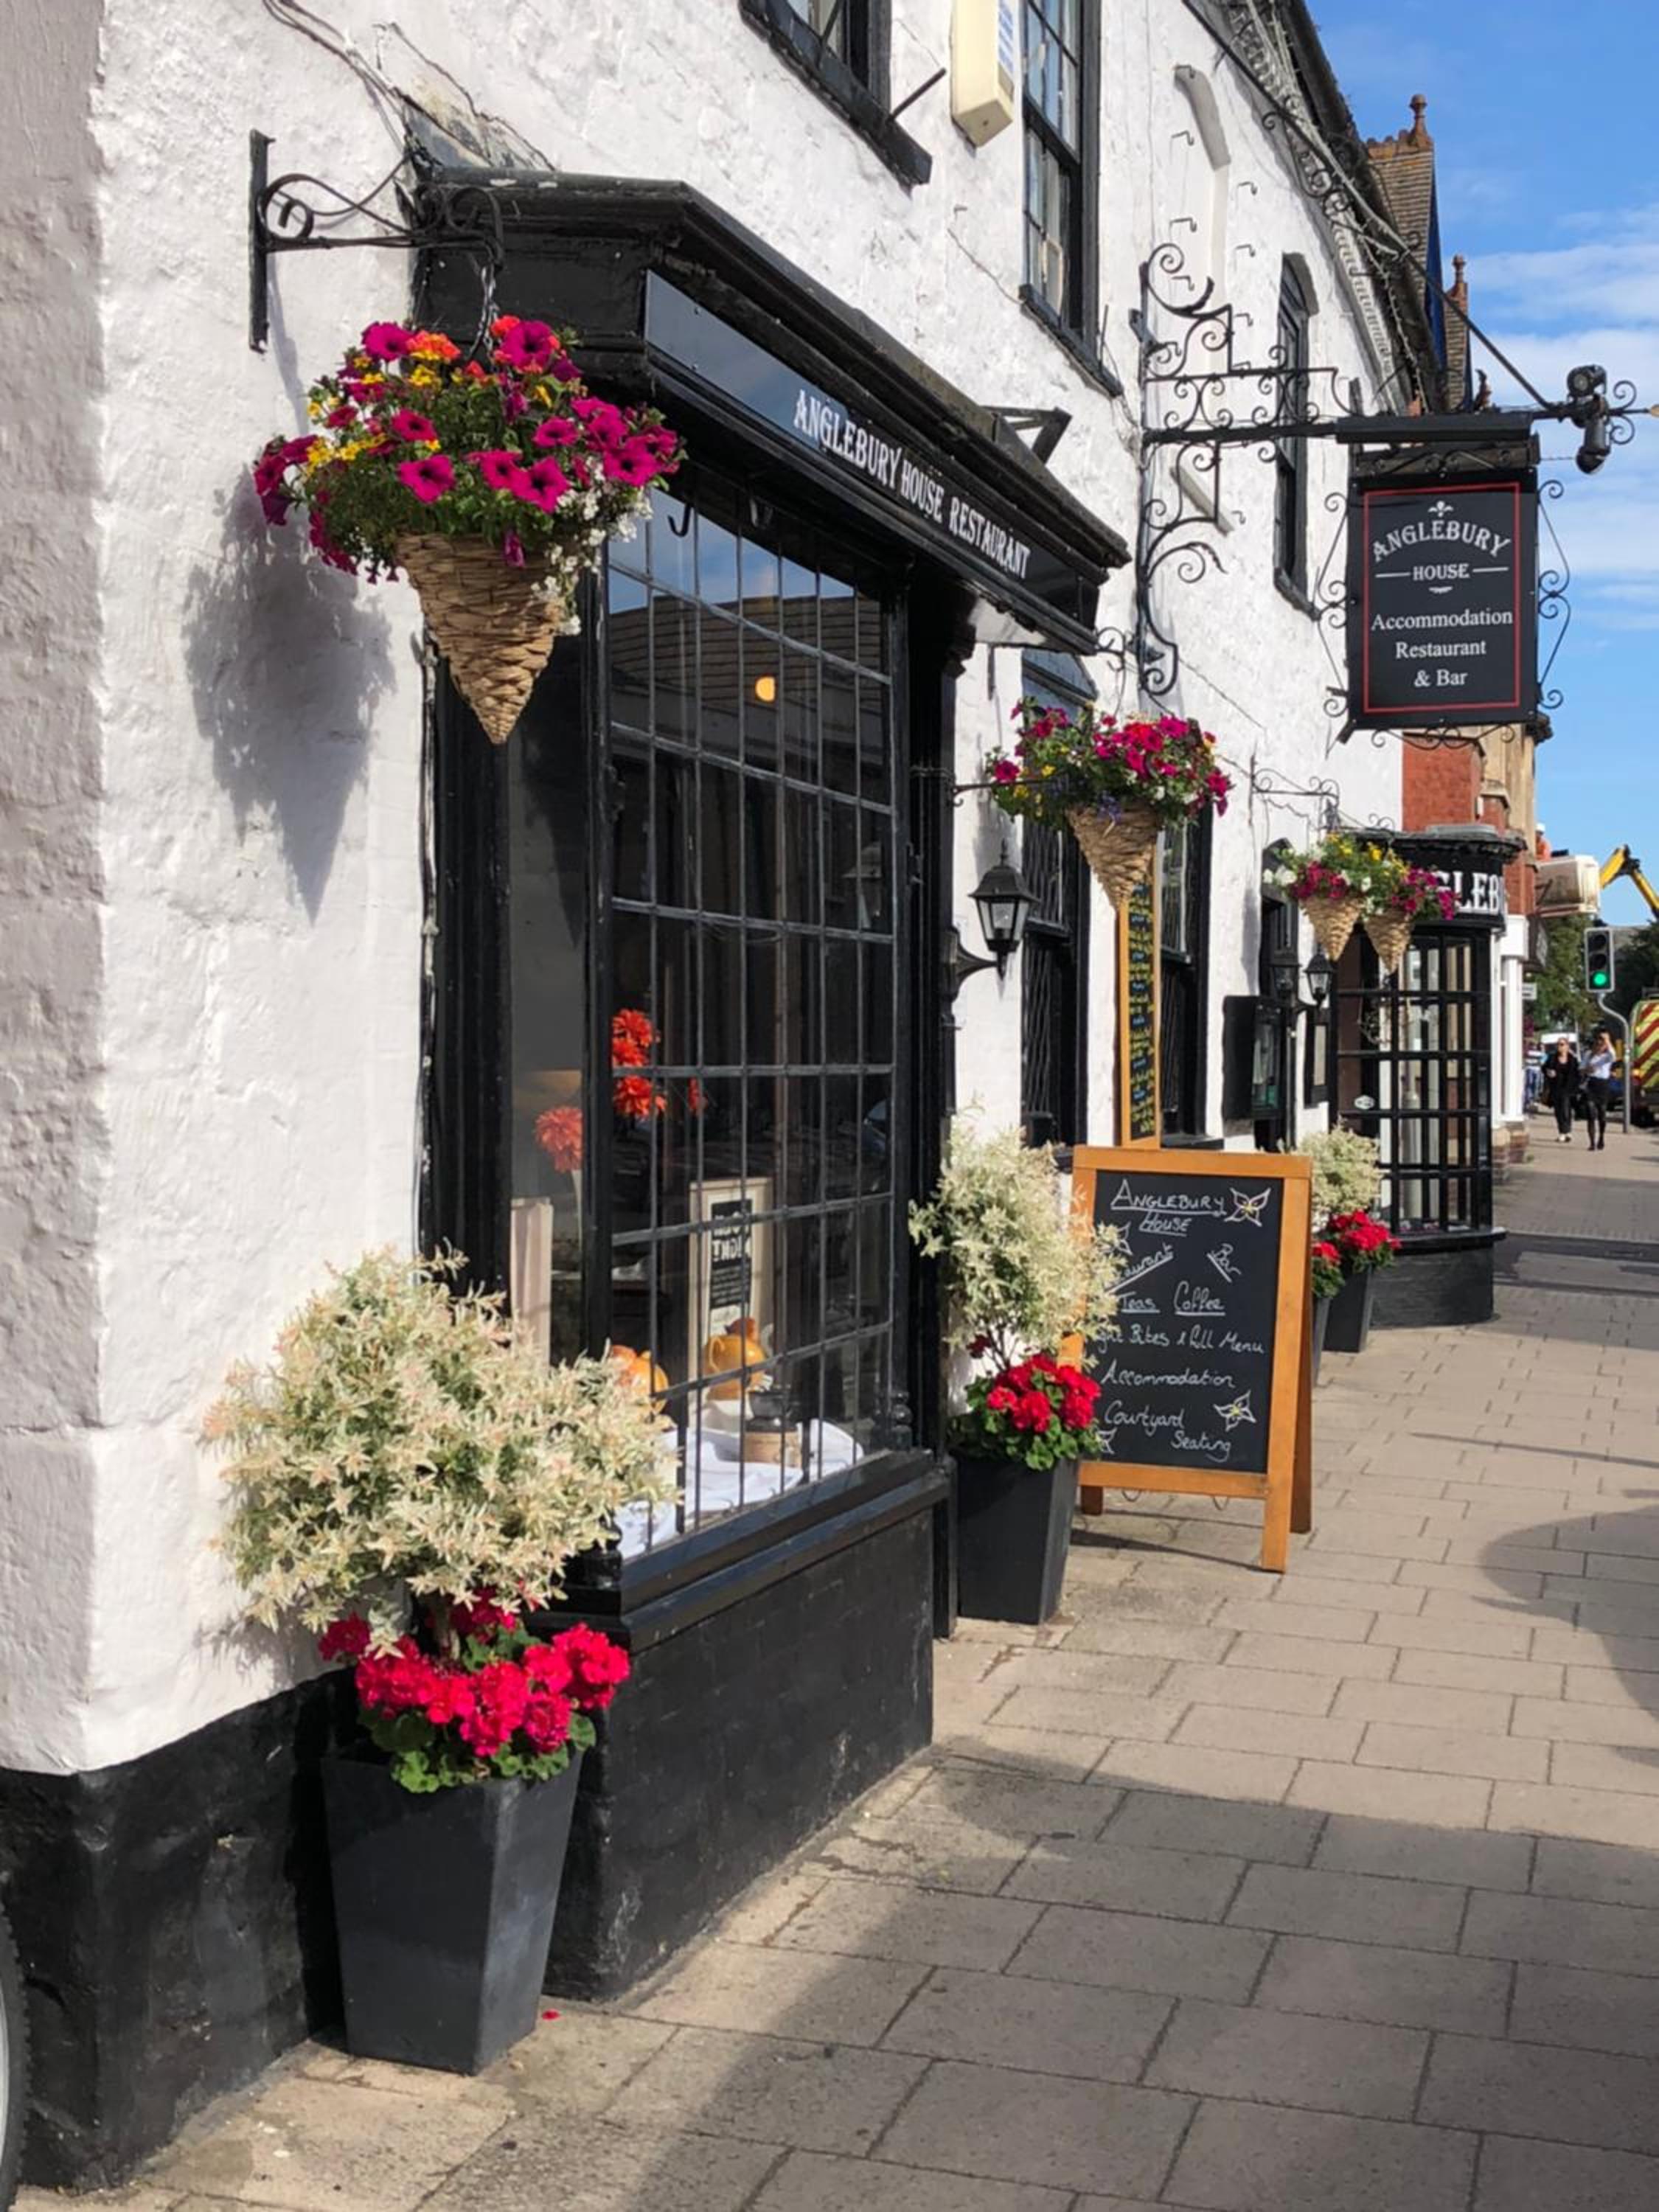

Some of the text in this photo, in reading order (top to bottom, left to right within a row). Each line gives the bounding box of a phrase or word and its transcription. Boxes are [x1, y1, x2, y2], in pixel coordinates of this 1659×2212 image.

[793, 389, 1031, 579] ANGLEBURY HOUSE RESTAURANT
[1372, 519, 1511, 563] ANGLEBURY
[1413, 563, 1470, 580] HOUSE
[1371, 608, 1513, 631] Accommodation
[1395, 640, 1486, 659] Restaurant
[1413, 669, 1469, 687] & Bar
[1110, 1178, 1225, 1217] ANGLEBURY
[1211, 1243, 1242, 1275] Bar
[1174, 1281, 1225, 1312] Coffee
[1130, 1324, 1171, 1347] Bites
[1218, 1330, 1265, 1354] Menu
[1104, 1399, 1185, 1436] Courtyard
[1170, 1430, 1231, 1463] Seating
